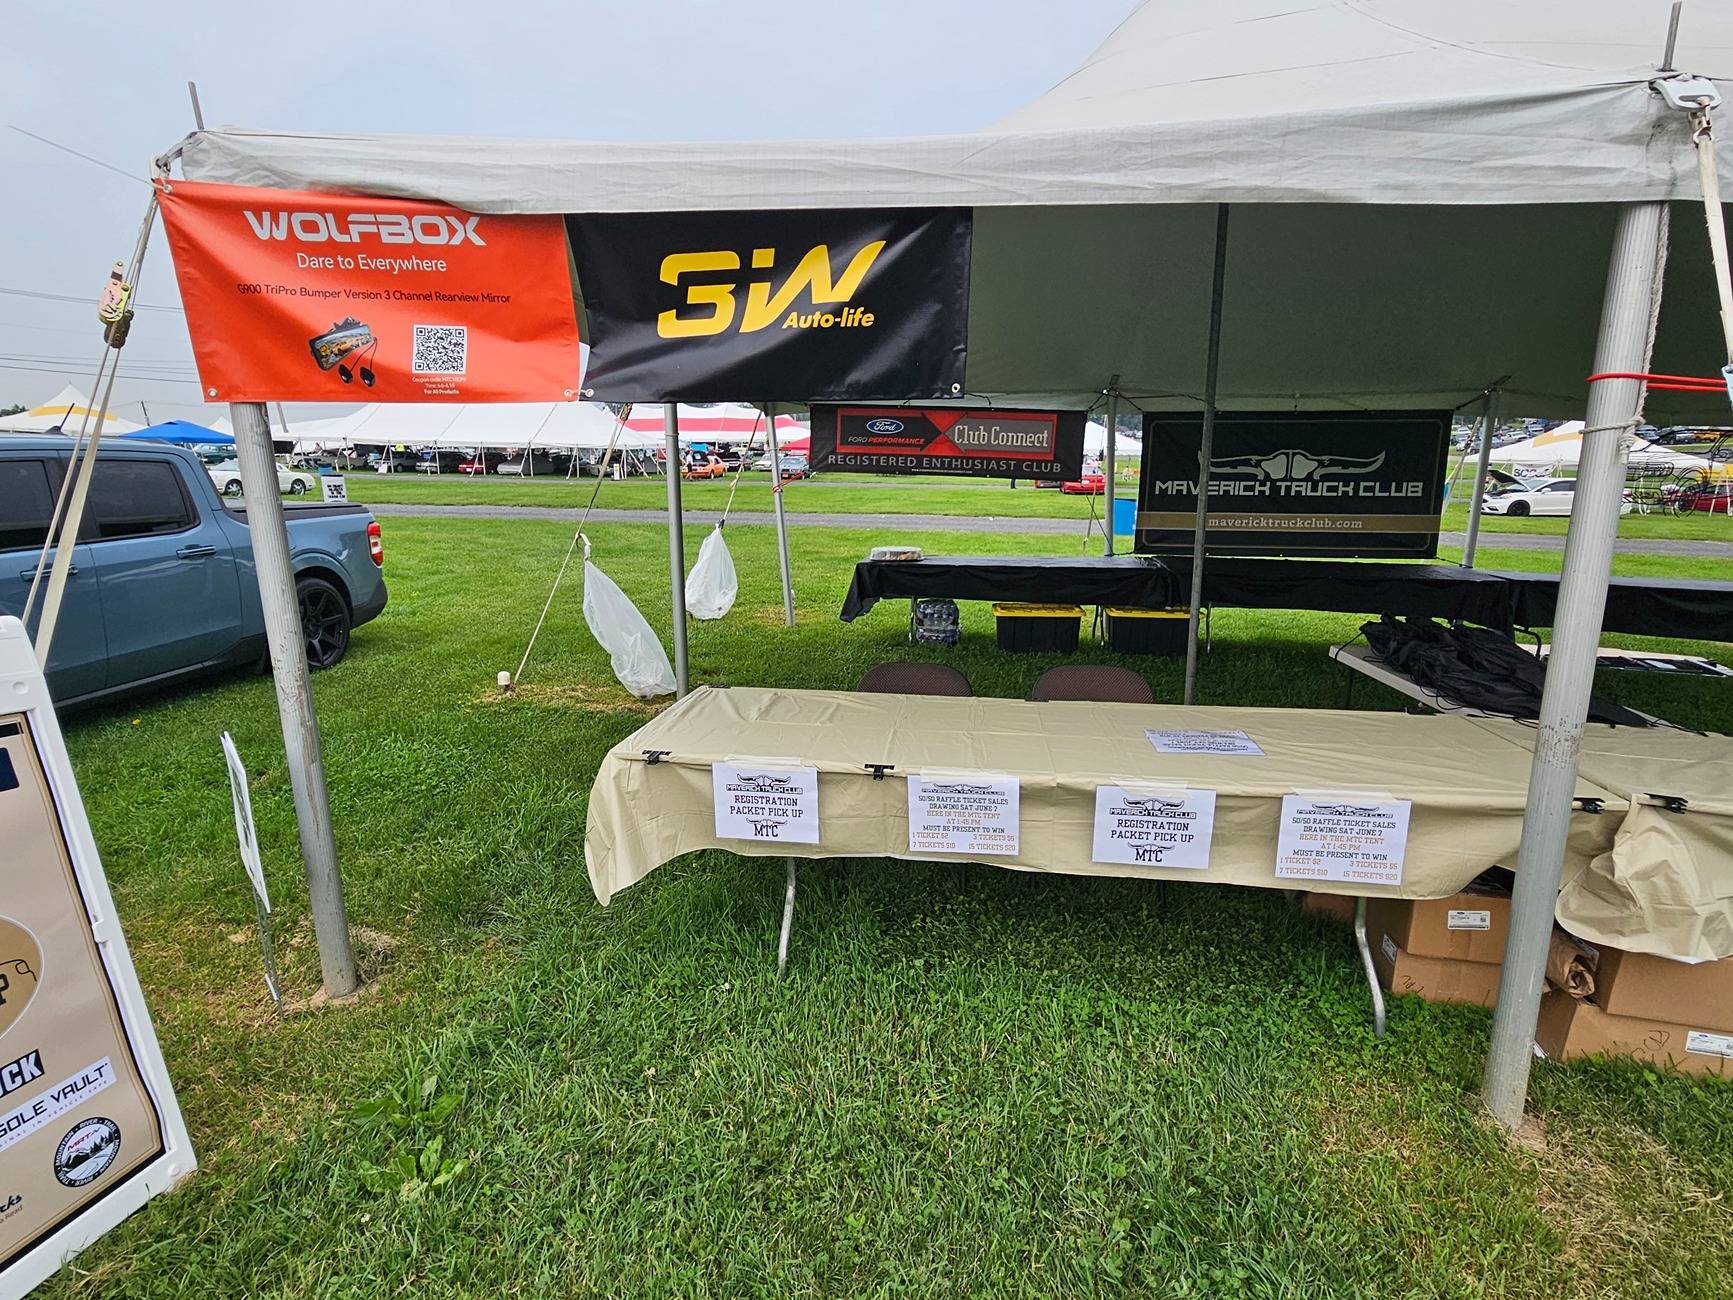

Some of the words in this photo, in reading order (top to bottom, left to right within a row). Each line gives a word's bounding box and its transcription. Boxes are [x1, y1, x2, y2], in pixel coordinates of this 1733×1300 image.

[242, 210, 488, 246] WOLFBOX
[296, 252, 334, 269] Dare
[337, 254, 355, 269] to
[357, 254, 447, 274] Everywhere
[237, 283, 262, 295] G900
[264, 284, 297, 296] TriPro
[299, 287, 341, 300] Bumper
[343, 288, 382, 300] Version
[383, 289, 391, 300] 3
[392, 289, 433, 301] Channel
[434, 291, 480, 303] Rearview
[480, 291, 511, 304] Mirror
[782, 306, 875, 329] Auto-life
[868, 436, 926, 445] PERFORMANCE
[954, 425, 988, 444] Club
[991, 426, 1049, 447] Connect
[828, 454, 917, 467] REGISTERED
[922, 457, 1017, 471] ENTHUSIAST
[1022, 461, 1061, 473] CLUB
[1276, 481, 1355, 497] TRUCK
[1358, 481, 1424, 497] CLUB
[1207, 516, 1362, 529] mavericktruckclub.com
[734, 794, 798, 807] REGISTRATION
[936, 795, 961, 803] RAFFLE
[730, 805, 766, 816] PACKET
[768, 807, 789, 818] PICK
[791, 809, 804, 818] UP
[929, 803, 959, 811] DRAWING
[922, 824, 941, 832] MUST
[952, 825, 980, 833] PRESENT
[1117, 819, 1190, 832] REGISTRATION
[1292, 816, 1311, 825] 50/50
[1312, 817, 1341, 826] RAFFLE
[1343, 819, 1371, 828] TICKET
[1372, 821, 1396, 829] SALES
[753, 823, 779, 838] MTC
[1110, 830, 1151, 841] PACKET
[1153, 832, 1177, 842] PICK
[1180, 834, 1194, 843] UP
[1303, 825, 1338, 834] DRAWING
[1338, 827, 1354, 835] SAT
[1356, 828, 1377, 836] JUNE
[979, 834, 1006, 842] TICKETS
[1299, 833, 1319, 841] HERE
[1330, 834, 1345, 842] THE
[1346, 835, 1364, 843] MTC
[1364, 837, 1385, 845] TENT
[1320, 842, 1332, 850] AT
[1348, 844, 1361, 852] PM
[1134, 848, 1163, 863] MTC
[1285, 857, 1312, 865] TICKET
[1292, 849, 1314, 857] MUST
[1315, 850, 1325, 858] BE
[1326, 851, 1360, 860] PRESENT
[1372, 853, 1388, 861] WIN
[1285, 867, 1316, 876] TICKETS
[1356, 861, 1388, 870] TICKETS
[1351, 871, 1384, 880] TICKETS
[0, 1052, 42, 1097] CK
[50, 1064, 105, 1103] VAULT
